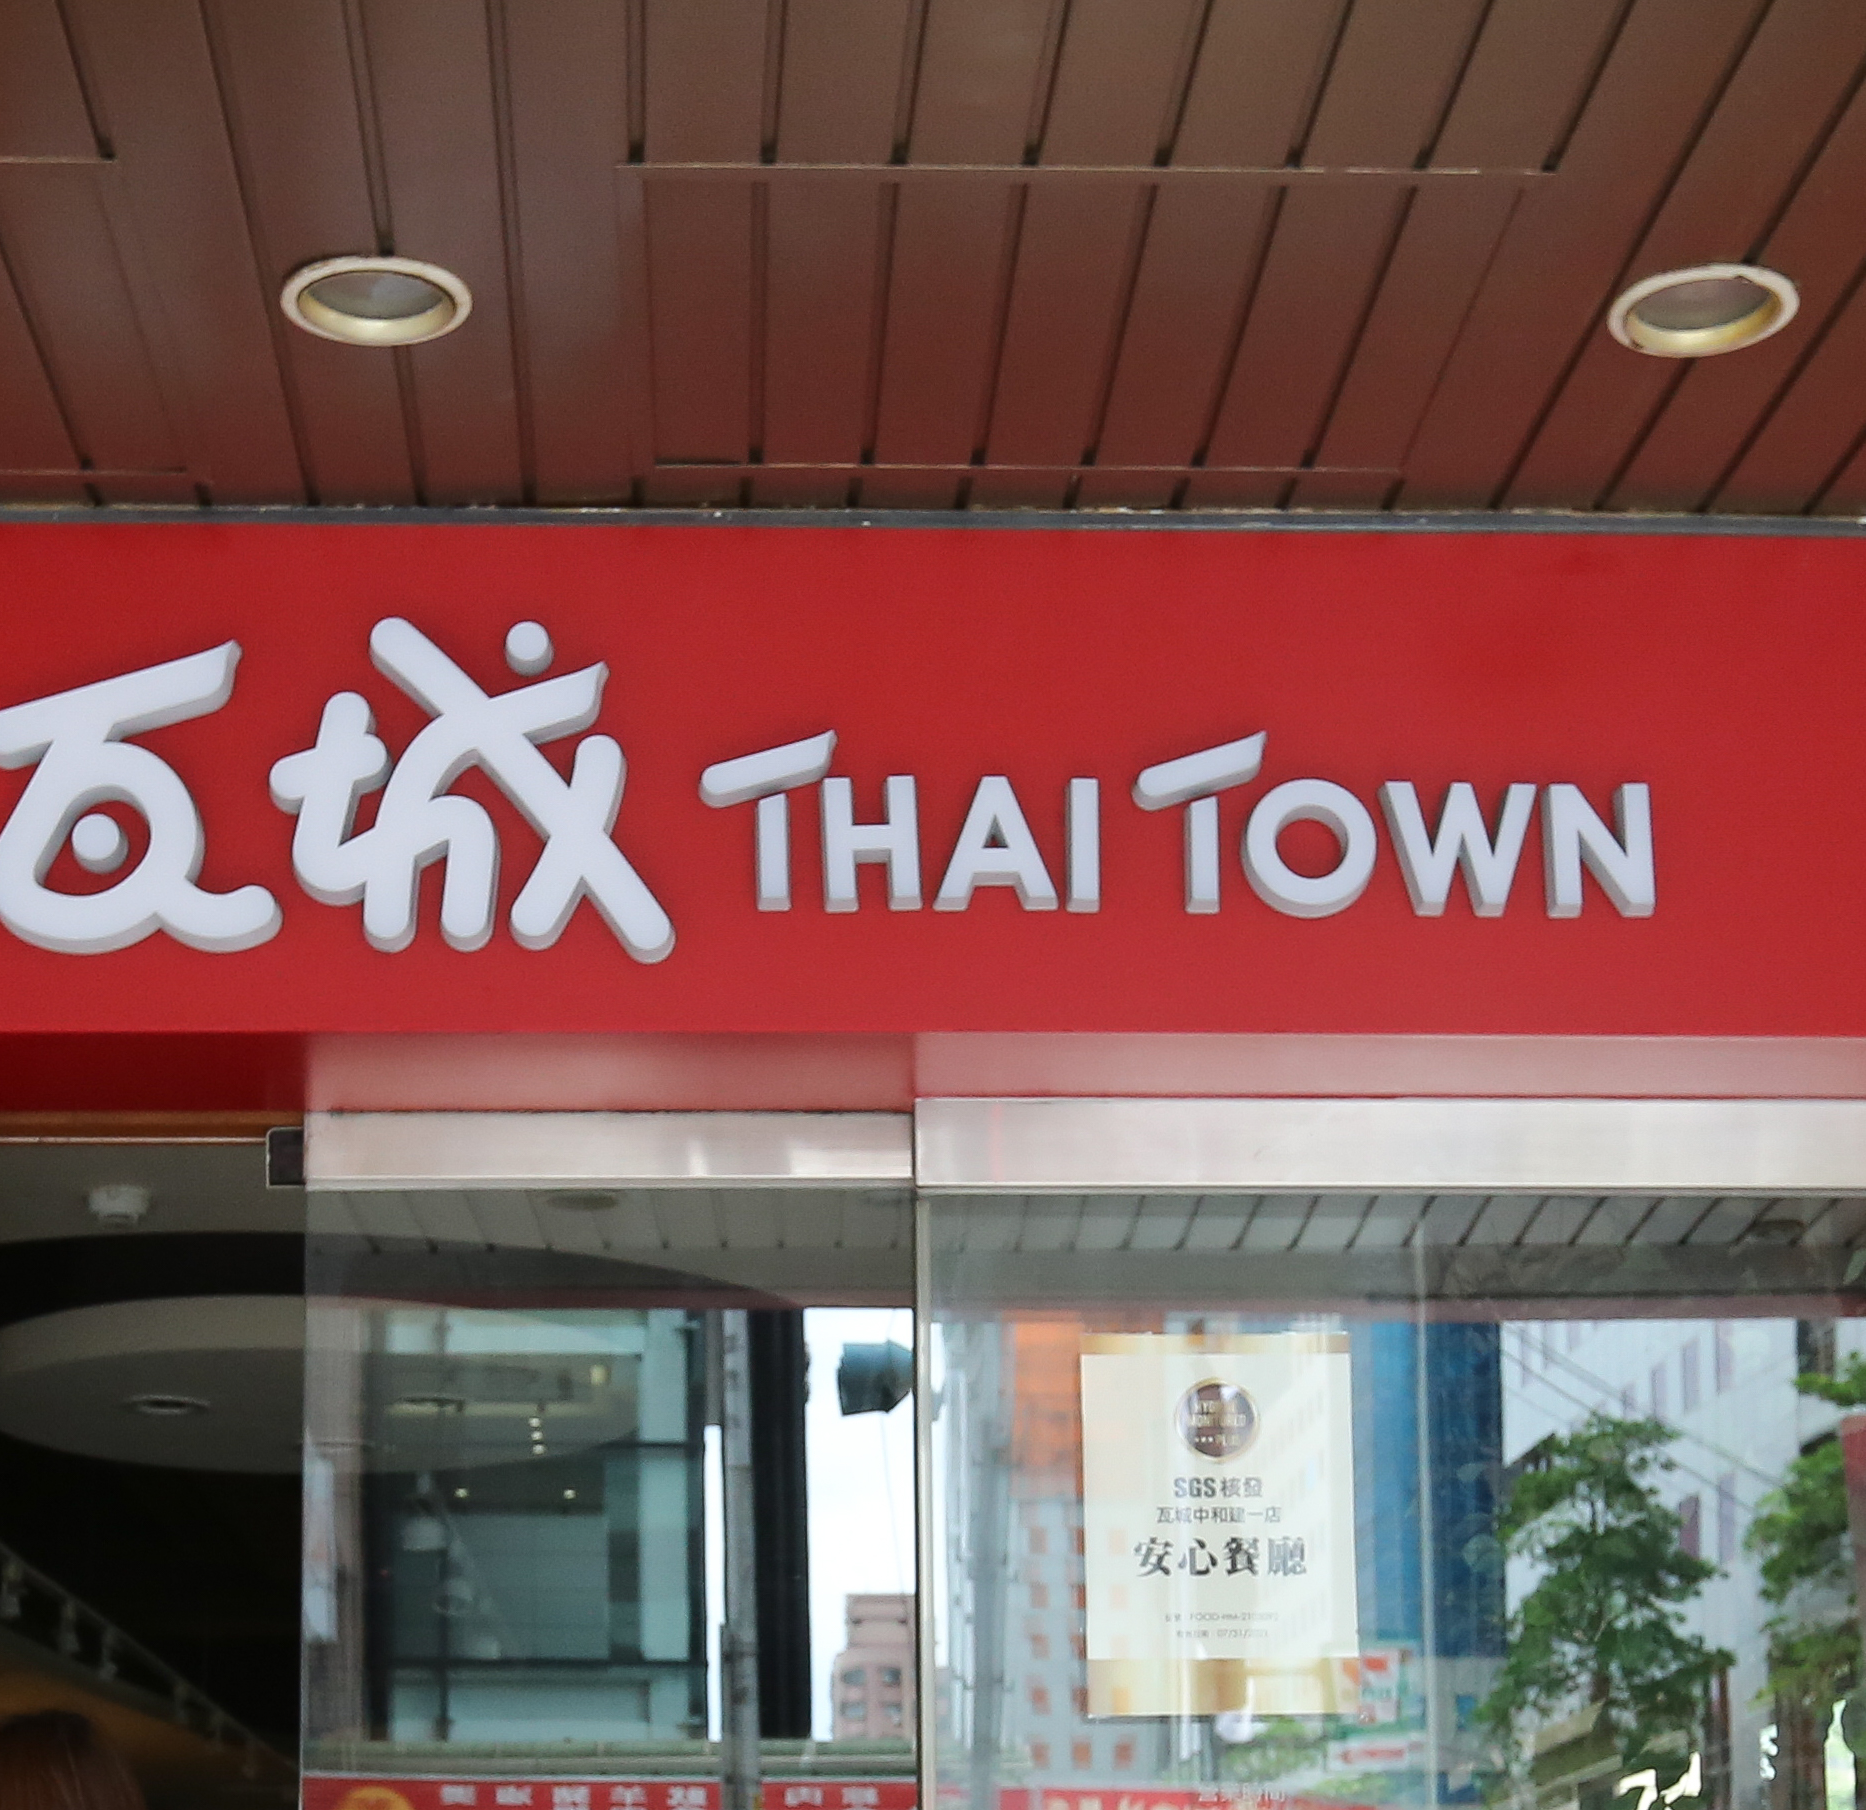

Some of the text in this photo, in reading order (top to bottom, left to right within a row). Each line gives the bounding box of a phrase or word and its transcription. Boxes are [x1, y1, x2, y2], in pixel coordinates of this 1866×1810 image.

[700, 729, 1656, 920] THAI TOWN
[1134, 1535, 1308, 1578] 安心餐廳
